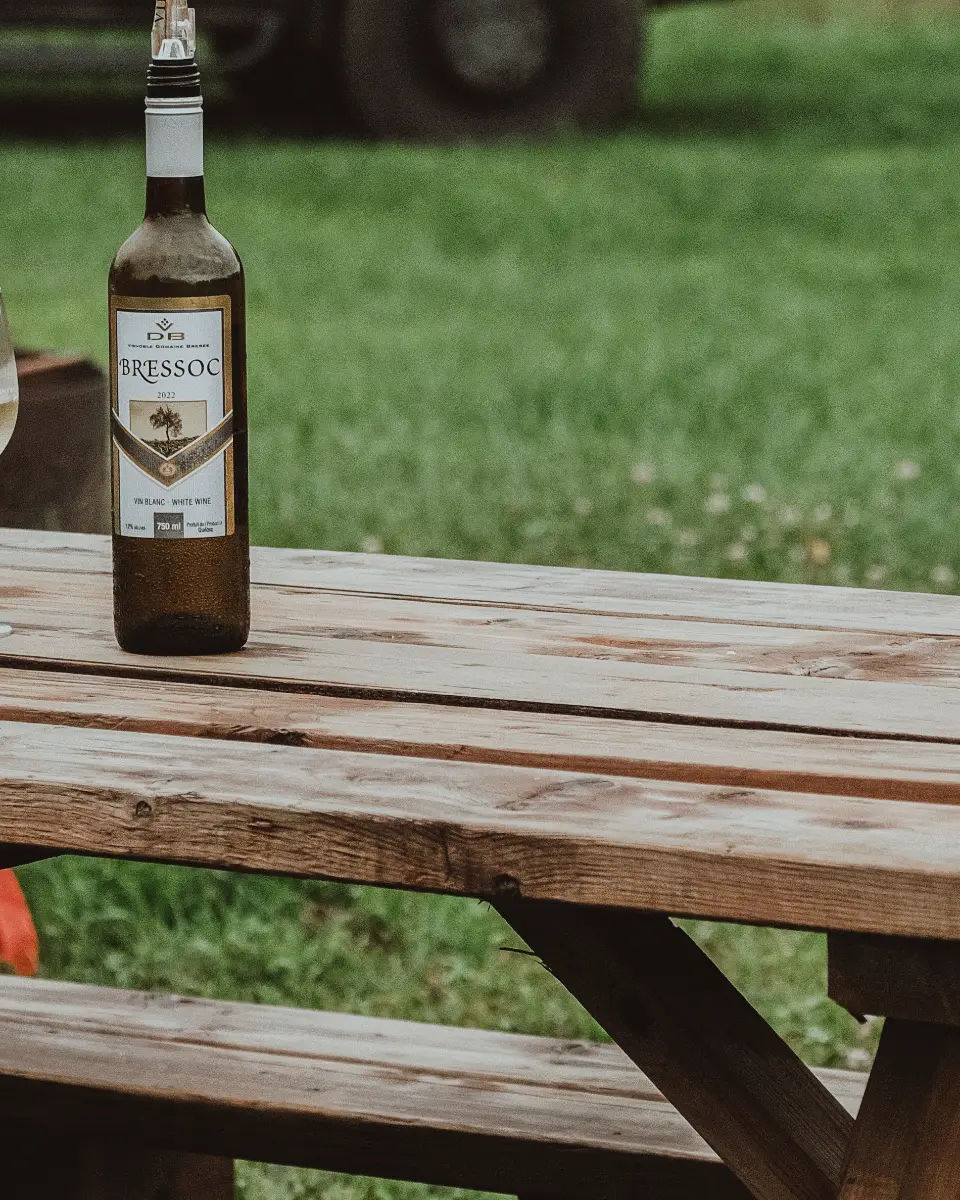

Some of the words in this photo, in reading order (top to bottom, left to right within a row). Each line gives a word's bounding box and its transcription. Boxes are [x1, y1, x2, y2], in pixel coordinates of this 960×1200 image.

[119, 357, 220, 384] BRESSOC
[157, 391, 176, 399] 2022
[133, 497, 144, 505] VIN
[144, 498, 166, 506] BLANC
[171, 498, 193, 506] WHITE
[194, 497, 212, 505] WINE
[156, 522, 171, 530] 750
[171, 522, 181, 530] ml
